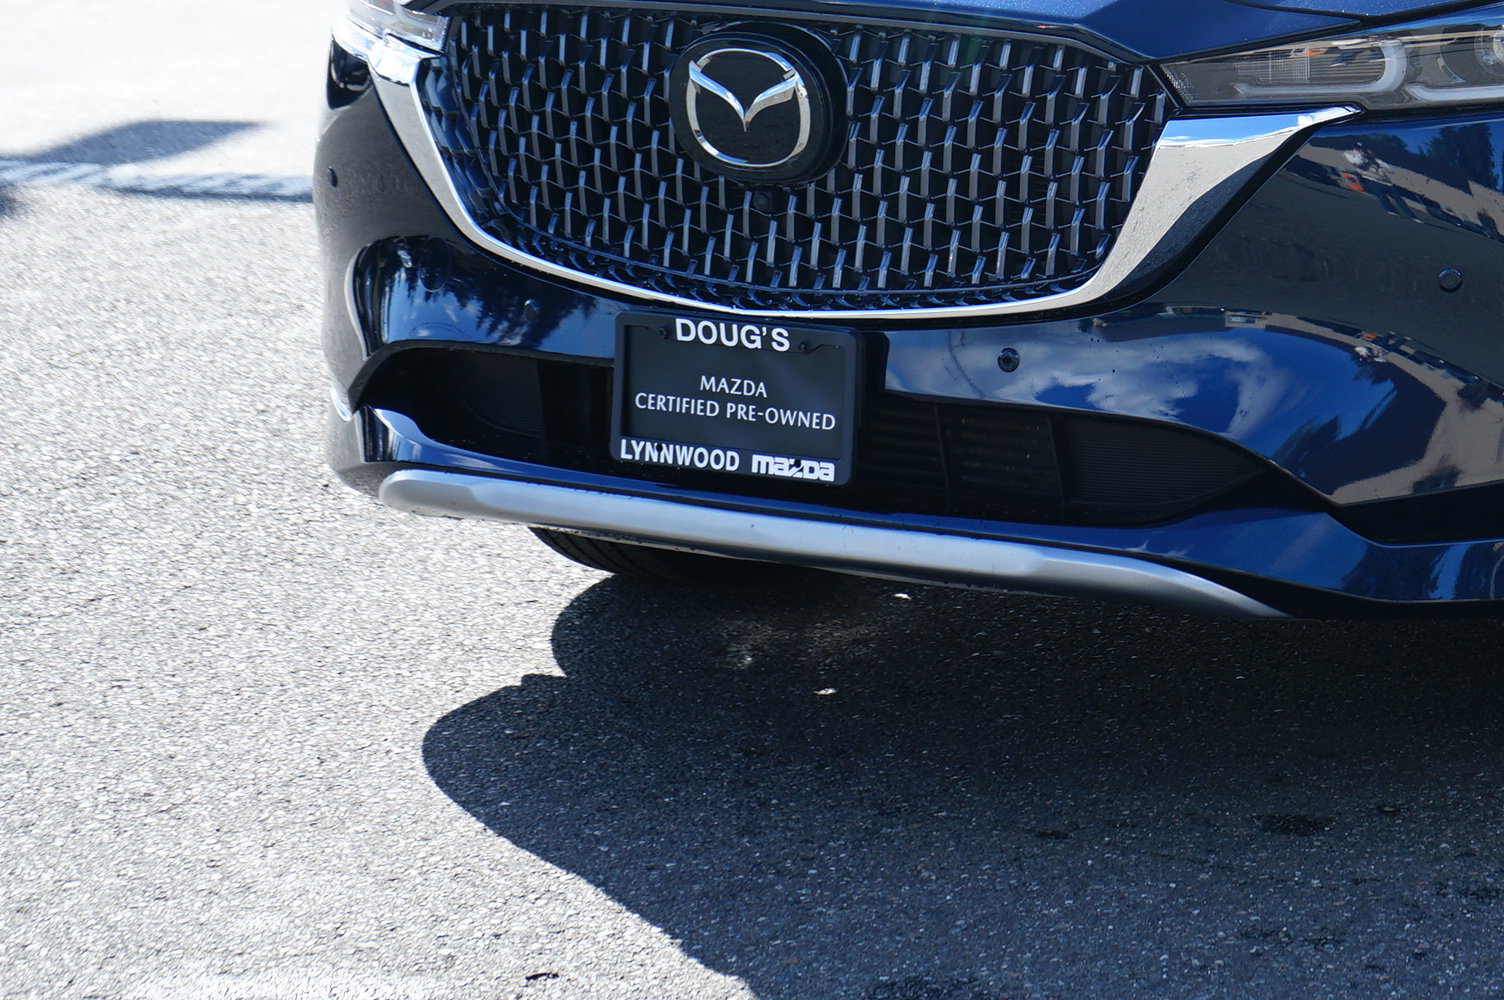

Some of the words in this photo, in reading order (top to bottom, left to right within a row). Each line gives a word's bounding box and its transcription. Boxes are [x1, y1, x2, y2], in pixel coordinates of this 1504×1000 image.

[675, 318, 790, 352] DOUG'S
[699, 375, 768, 398] MAZDA
[634, 393, 720, 417] CERTIFIED
[725, 402, 836, 431] PRE-OWNED
[620, 438, 740, 471] LYNNWOOD
